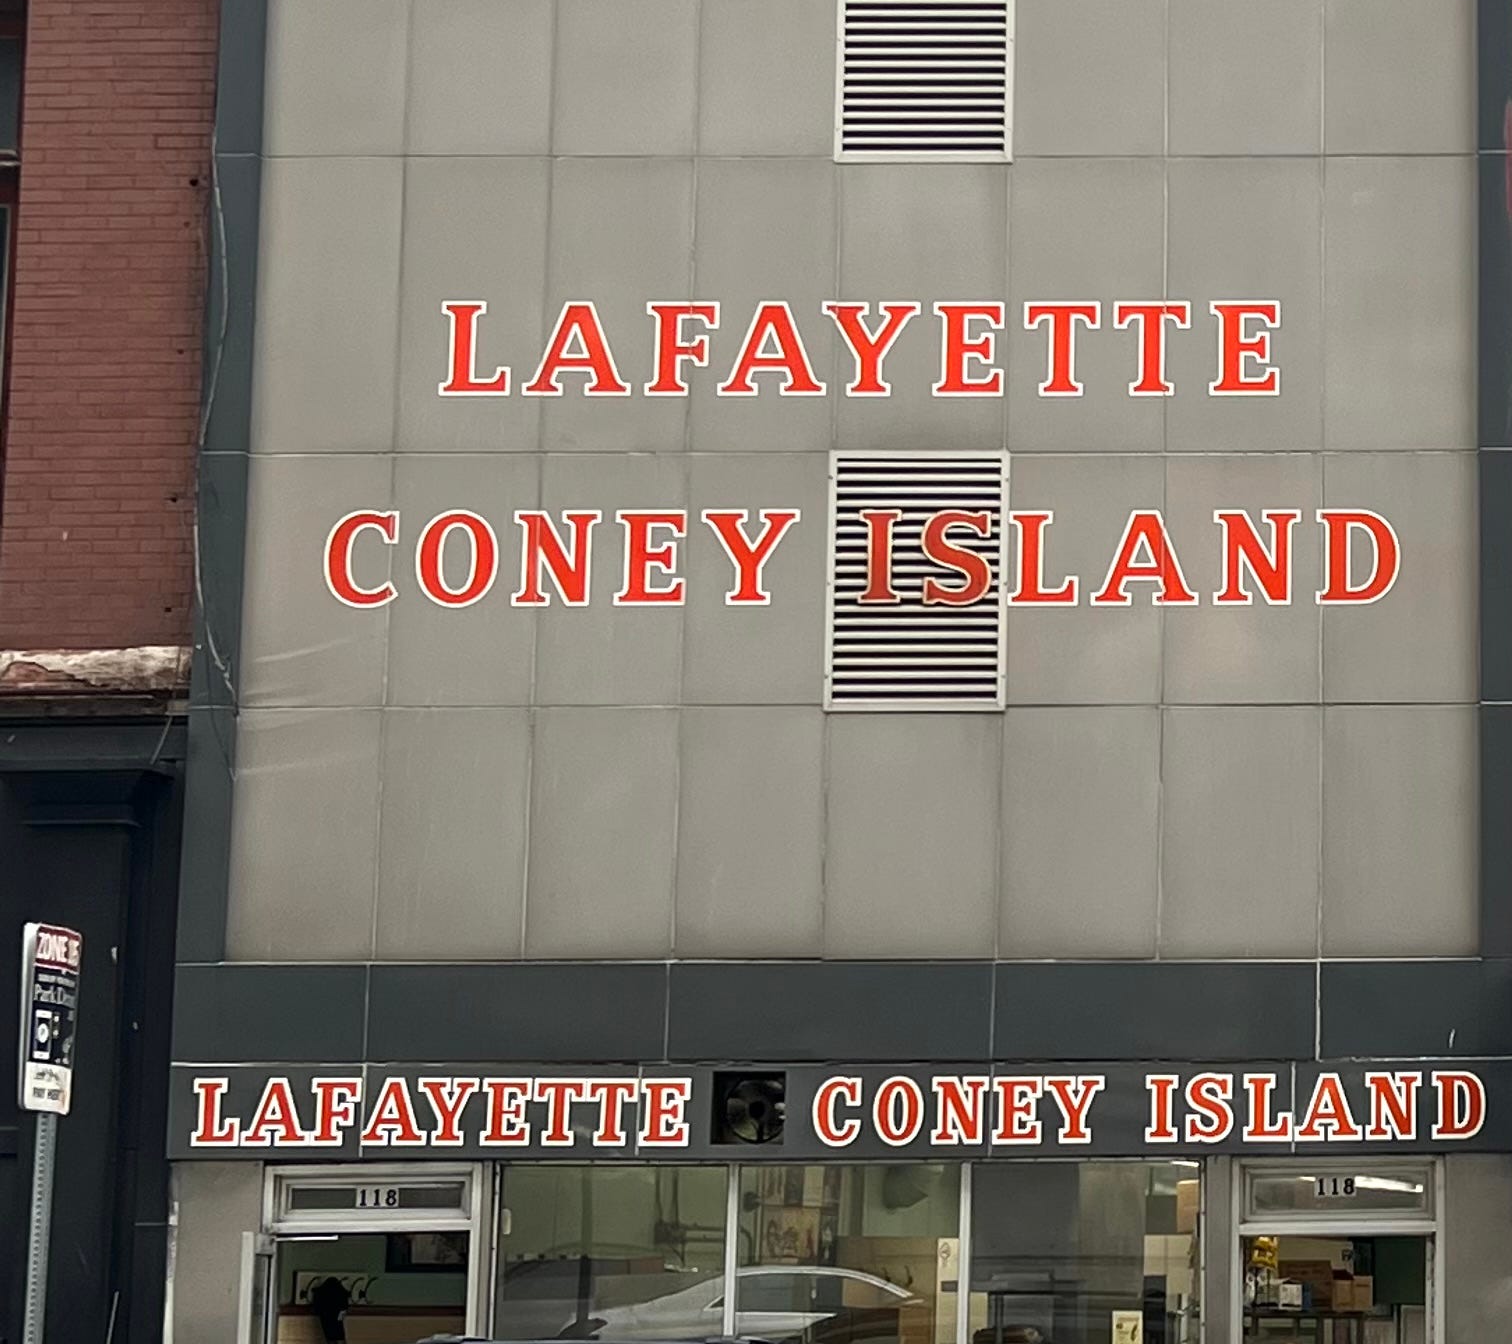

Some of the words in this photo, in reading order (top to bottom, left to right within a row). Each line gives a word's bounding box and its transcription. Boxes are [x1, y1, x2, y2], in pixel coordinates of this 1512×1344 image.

[438, 301, 1281, 396] LAFAYETTE
[324, 509, 800, 608] CONEY
[857, 509, 1401, 607] ISLAND
[190, 1076, 692, 1146] LAFAYETTE
[812, 1076, 1105, 1147] CONEY
[1145, 1070, 1487, 1143] ISLAND
[358, 1188, 398, 1207] 118
[1318, 1178, 1355, 1196] 118
